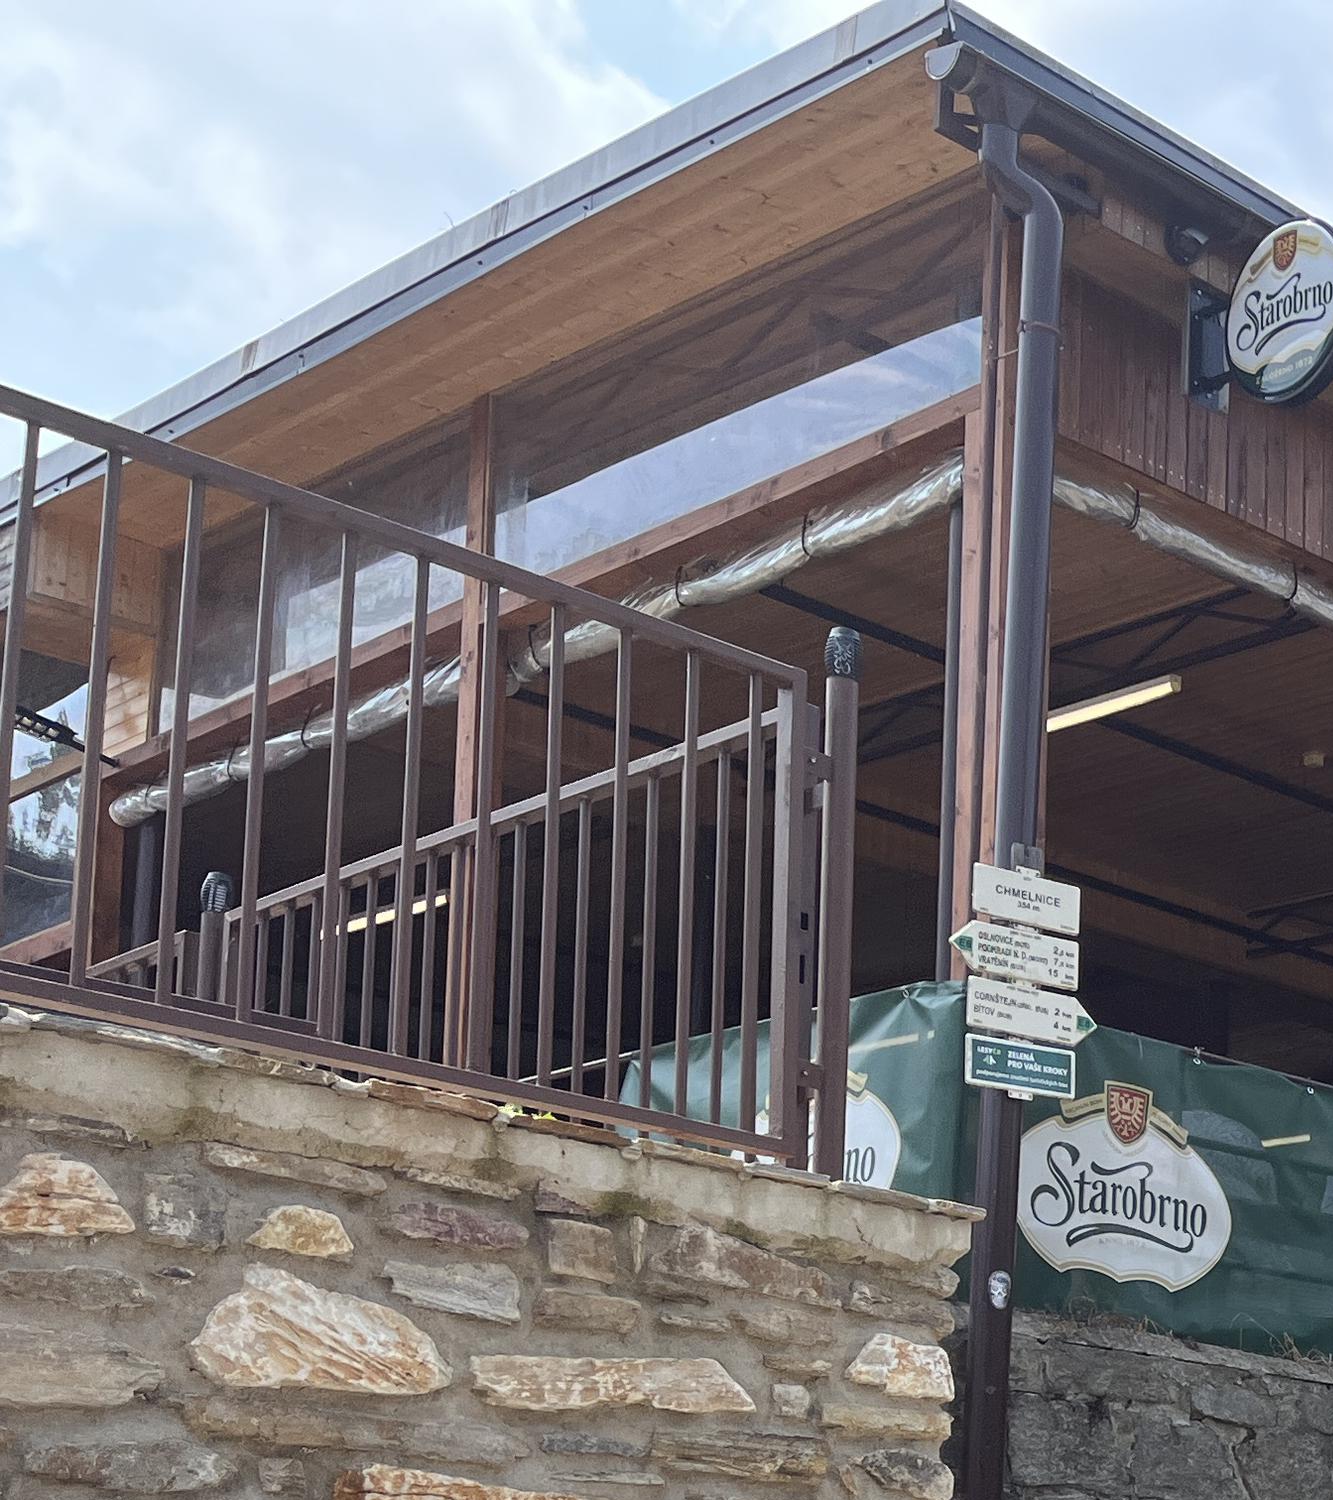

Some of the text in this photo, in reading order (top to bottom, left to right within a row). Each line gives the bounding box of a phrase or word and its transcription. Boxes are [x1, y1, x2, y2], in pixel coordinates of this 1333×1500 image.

[1236, 272, 1332, 356] Starobrno
[995, 884, 1061, 908] CHMELNICE
[978, 931, 1013, 945] OSLNOVICE
[1048, 968, 1058, 977] 15
[974, 990, 1017, 1007] CORNŠTEJN
[1054, 1008, 1060, 1016] 2
[973, 1003, 995, 1016] BÍTOV
[1053, 1021, 1059, 1030] 4
[1007, 1050, 1035, 1062] ZELENÁ
[1007, 1060, 1068, 1076] PRO VAŠE KROKY
[1031, 1141, 1207, 1253] Starobrno
